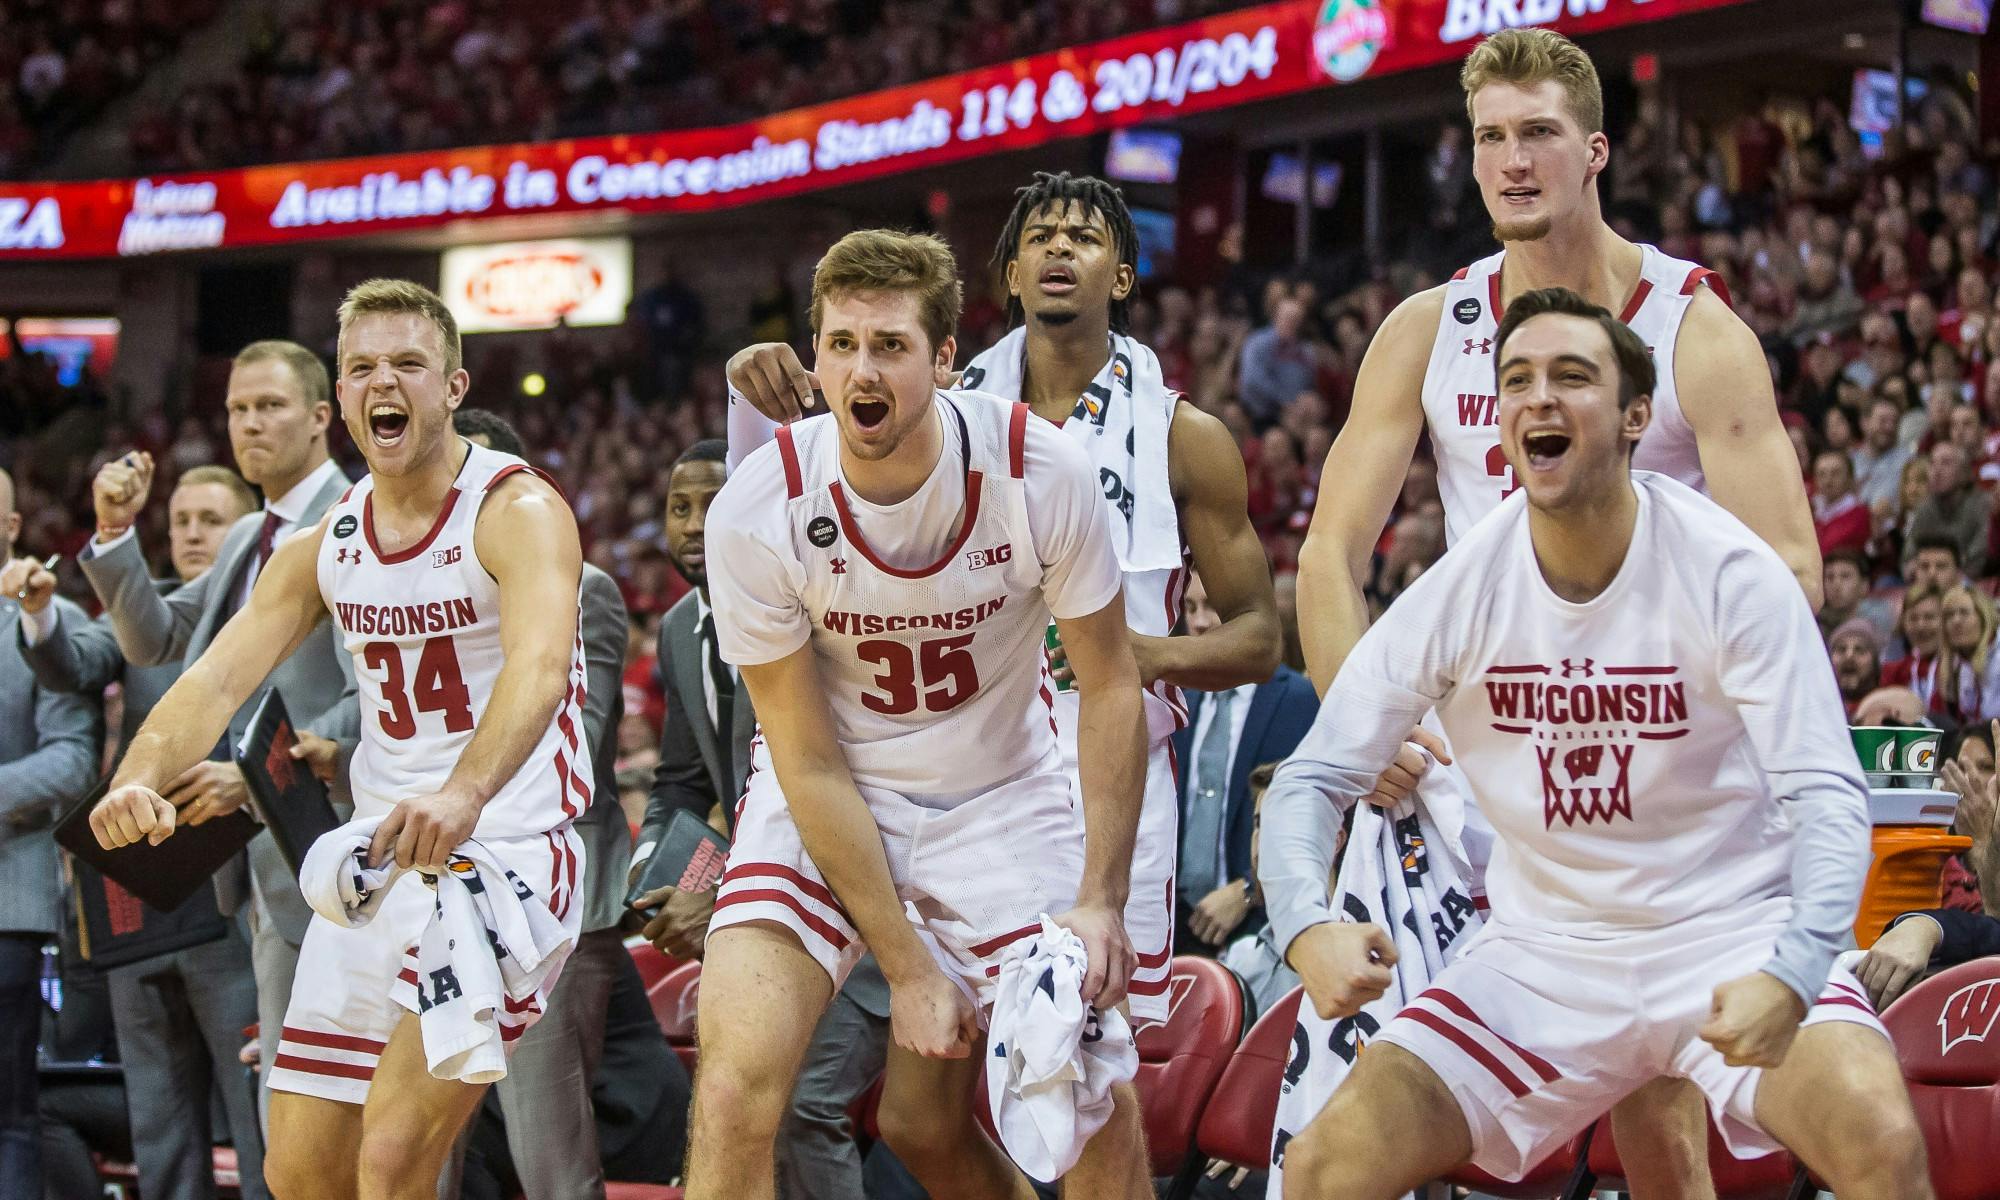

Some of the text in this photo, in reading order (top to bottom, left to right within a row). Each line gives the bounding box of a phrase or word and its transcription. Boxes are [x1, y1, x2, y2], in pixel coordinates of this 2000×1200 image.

[270, 180, 496, 228] Available
[504, 160, 559, 209] in
[566, 136, 811, 204] Concession
[814, 99, 952, 171] Stands
[957, 77, 1037, 141] 114
[1042, 70, 1087, 122] &
[1092, 26, 1278, 113] 201/204
[335, 597, 478, 636] WISCONSIN
[823, 595, 1009, 636] WISCONSIN
[363, 635, 475, 741] 34
[856, 632, 980, 715] 35
[679, 837, 717, 892] ISCONSIN
